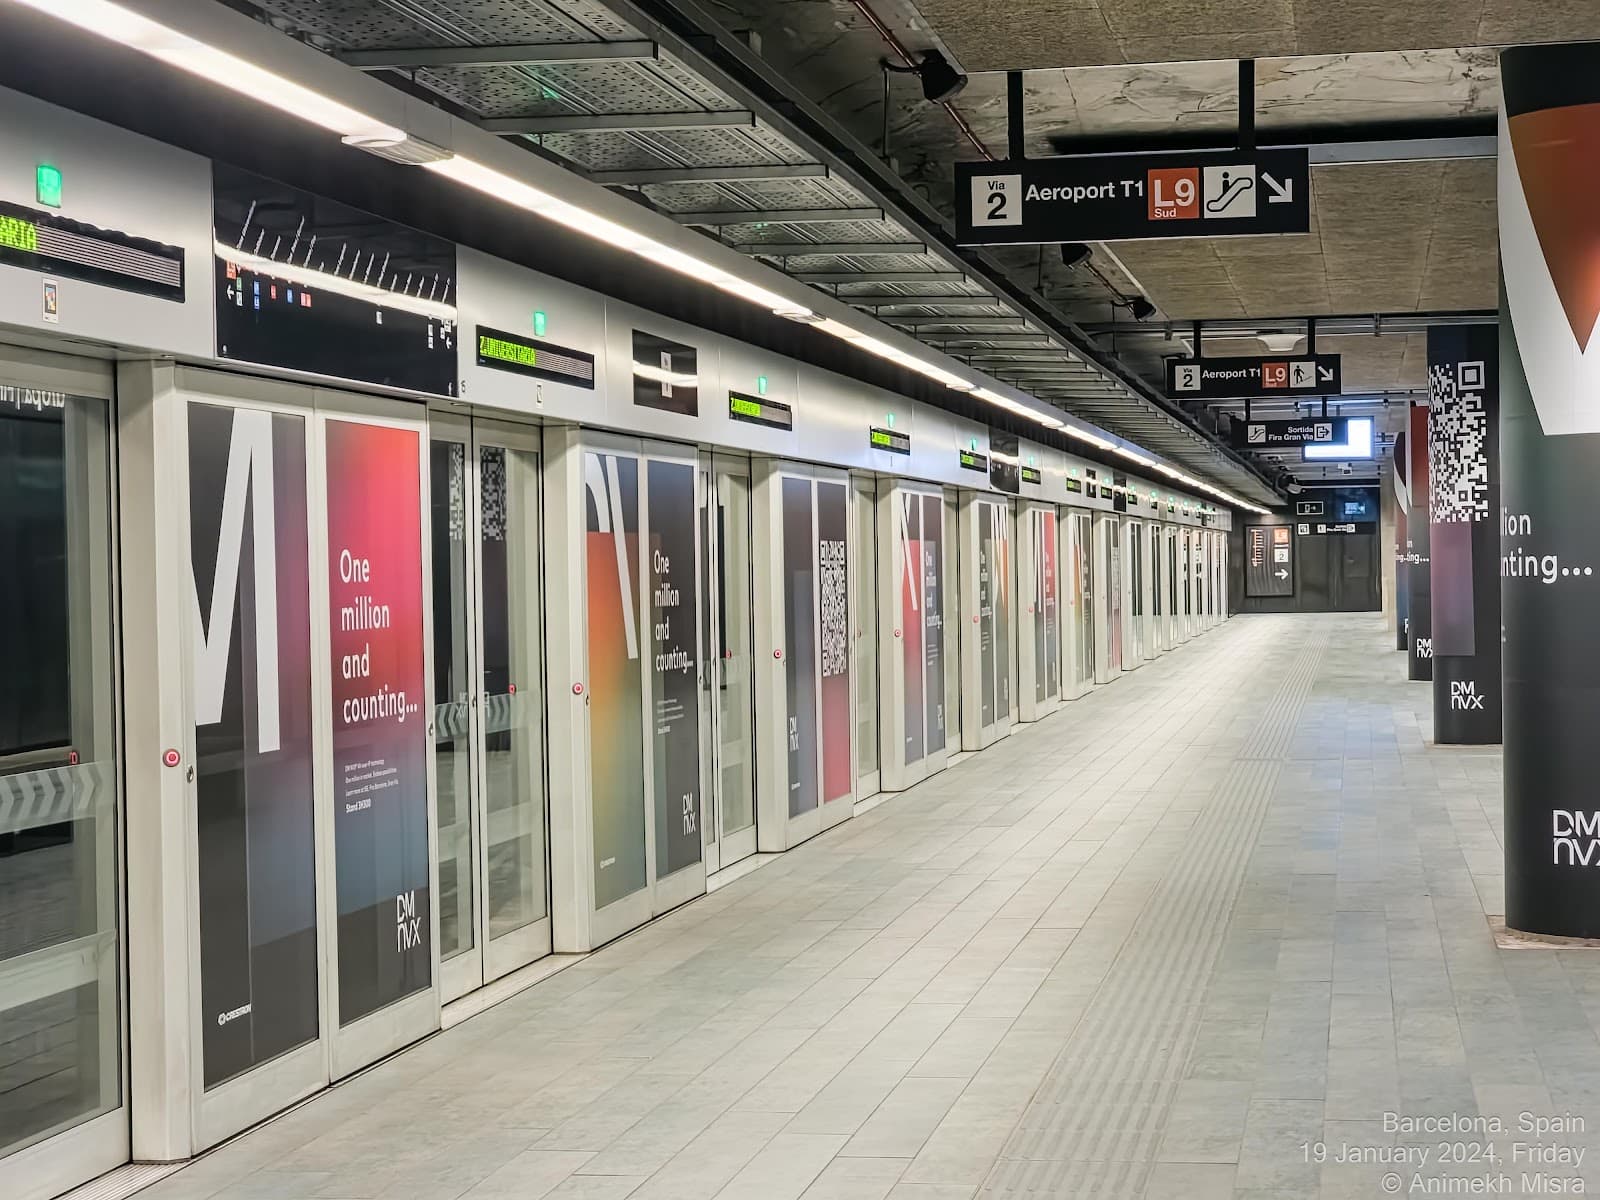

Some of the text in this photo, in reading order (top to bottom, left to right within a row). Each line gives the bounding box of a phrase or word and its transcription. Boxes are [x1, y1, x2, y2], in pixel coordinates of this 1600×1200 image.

[987, 180, 1006, 191] Via
[1025, 179, 1143, 203] Aeroport T1
[1153, 178, 1196, 208] L9
[986, 192, 1008, 220] 2
[1154, 207, 1177, 219] Sud
[1183, 373, 1193, 388] 2
[1202, 368, 1260, 380] Aeroport T1
[1265, 367, 1286, 383] L9
[1268, 433, 1314, 441] Fira Gran Via
[1287, 426, 1314, 434] Sortida
[340, 549, 370, 583] One
[654, 550, 669, 574] One
[654, 582, 679, 608] million
[341, 596, 390, 631] million
[655, 616, 669, 641] and
[342, 642, 370, 679] and
[1450, 680, 1475, 696] DM
[343, 683, 418, 723] counting...
[1553, 809, 1600, 837] DM
[397, 889, 415, 924] DM
